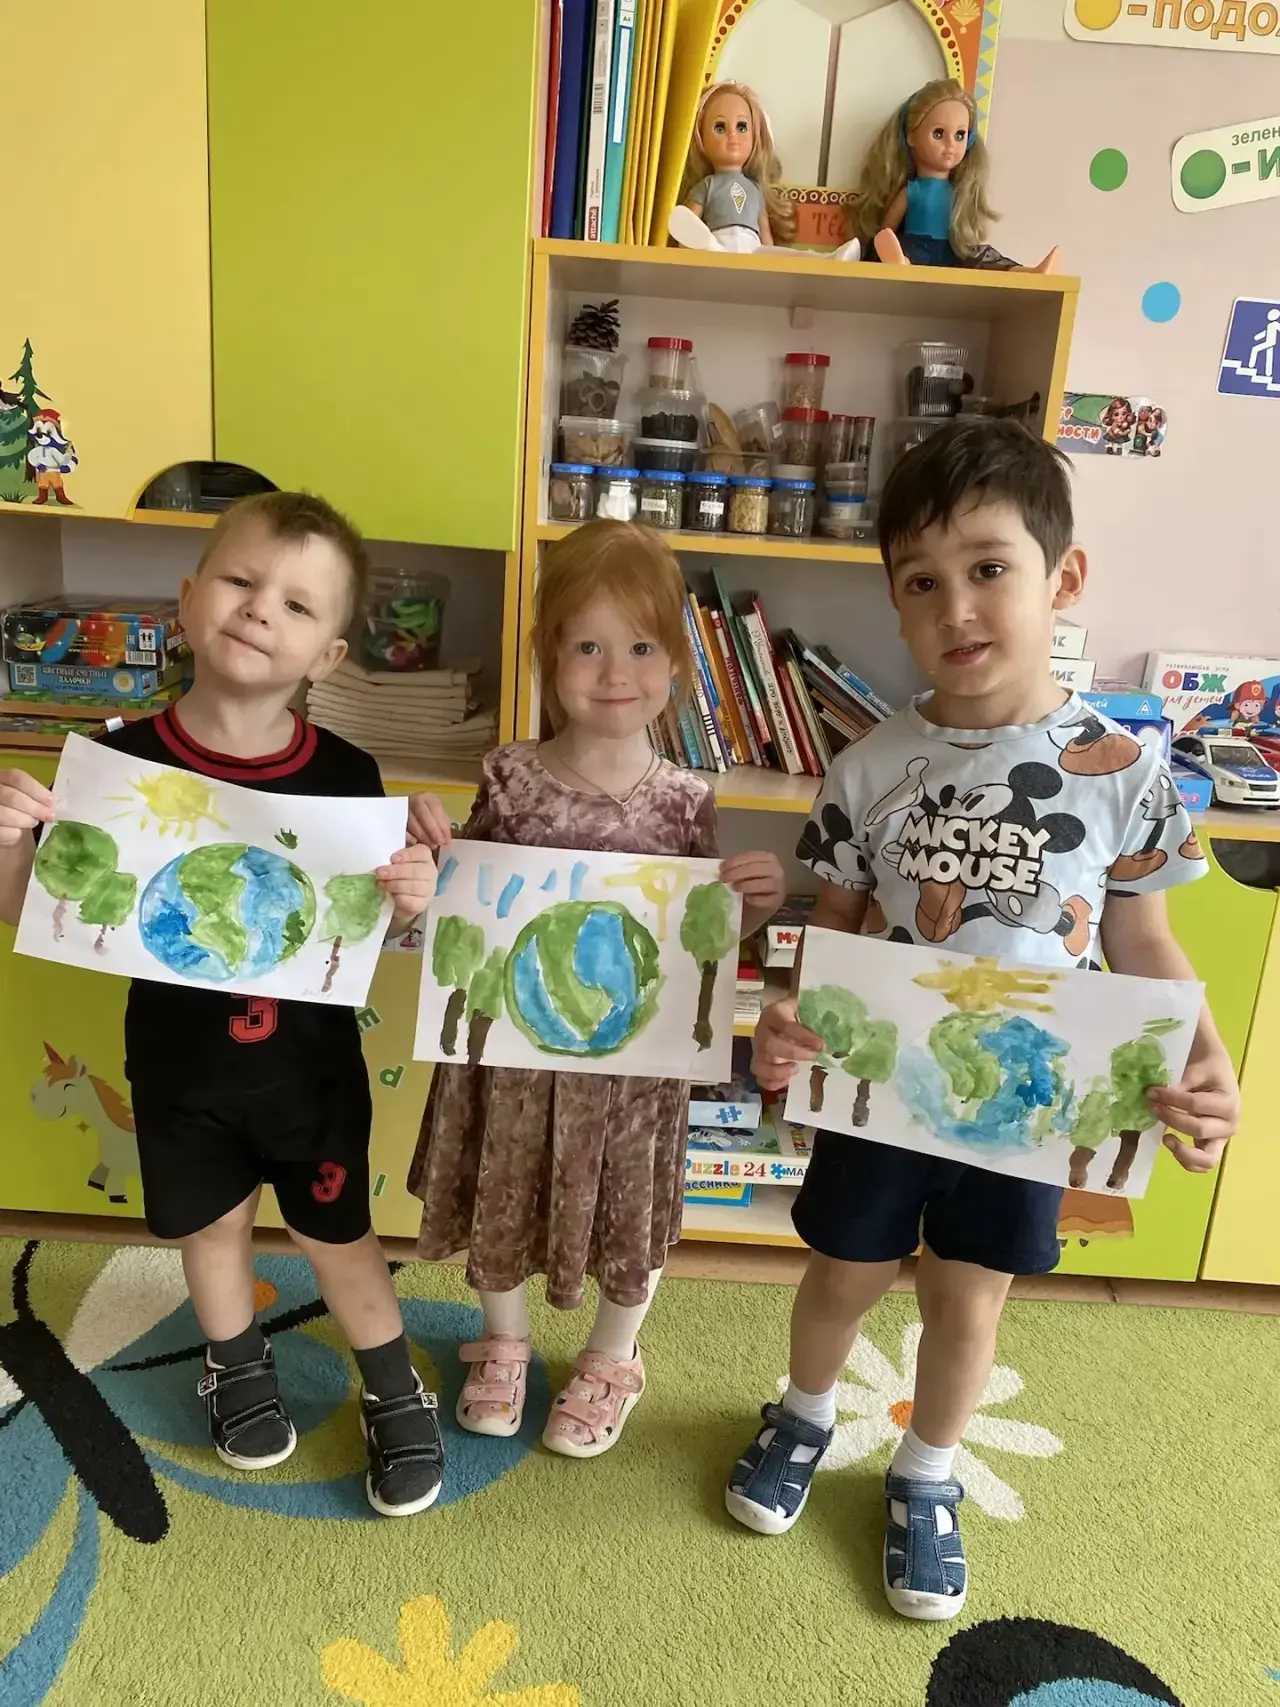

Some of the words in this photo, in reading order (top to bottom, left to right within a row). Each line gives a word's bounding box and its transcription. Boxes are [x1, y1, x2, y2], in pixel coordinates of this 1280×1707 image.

[1128, 0, 1280, 41] -ПОДО
[590, 208, 598, 239] attaché
[1162, 670, 1228, 692] ОБЖ
[1162, 695, 1183, 708] для
[1182, 694, 1223, 711] детей
[899, 815, 1051, 859] MICKEY
[899, 849, 1041, 895] MOUSE
[310, 1161, 347, 1203] 3
[743, 1161, 767, 1177] 24
